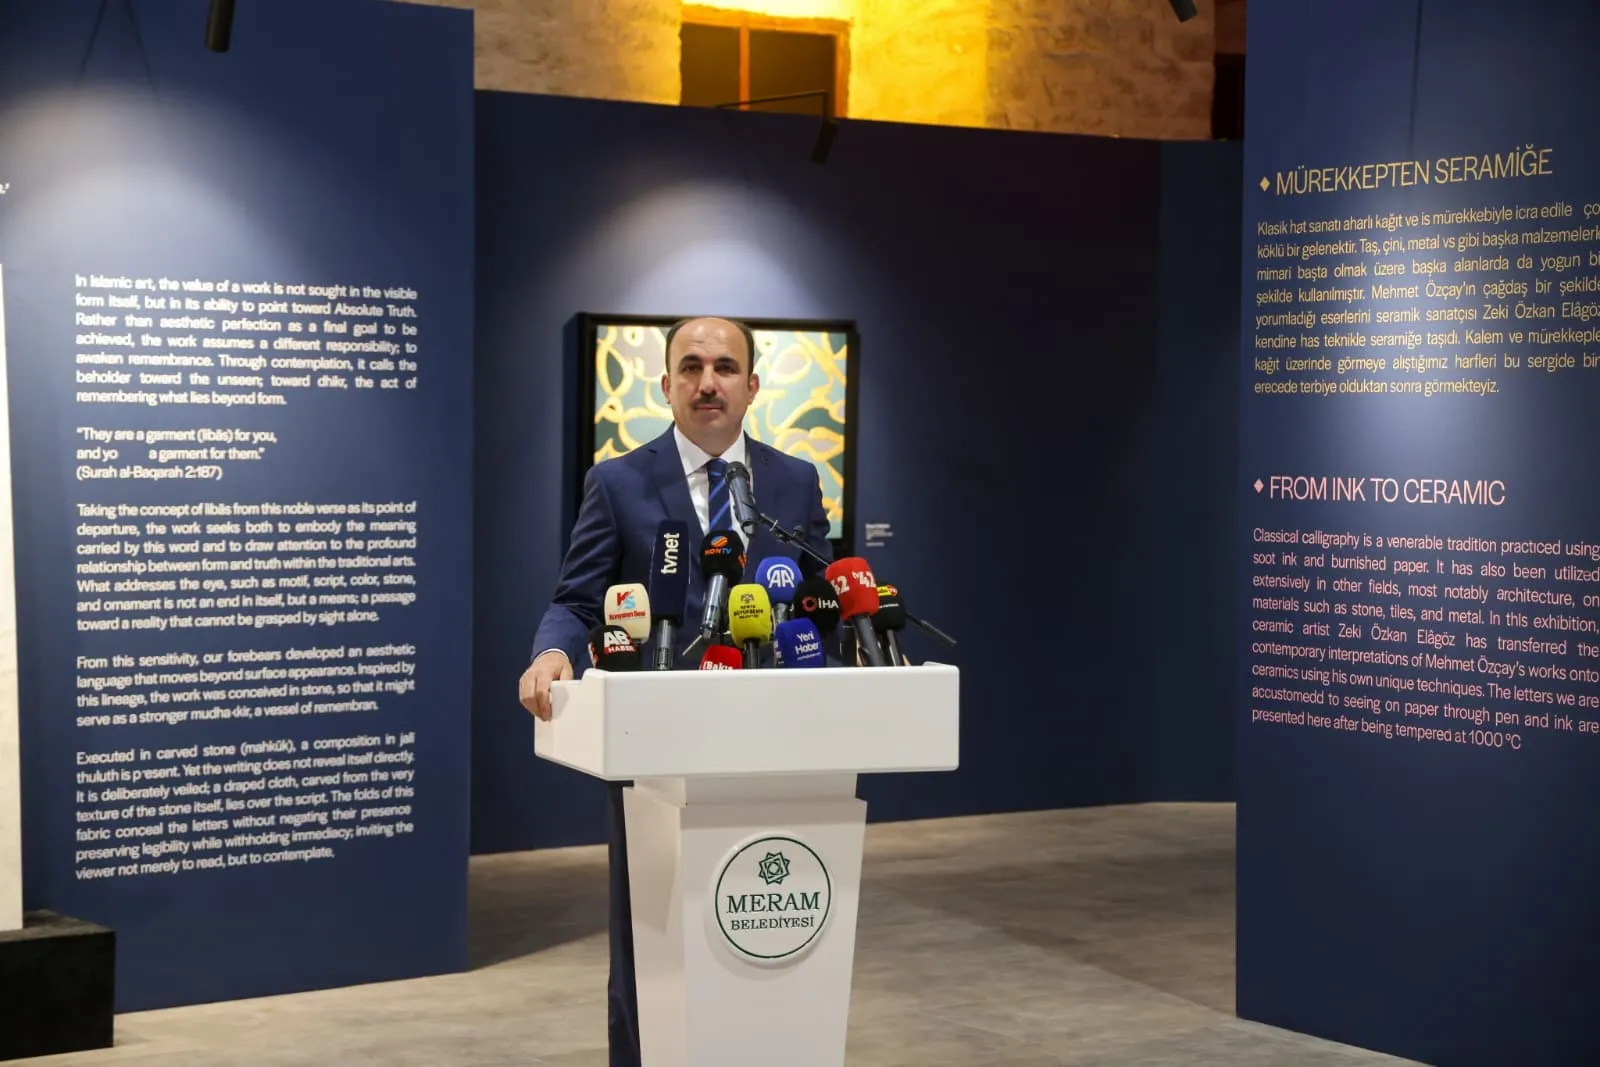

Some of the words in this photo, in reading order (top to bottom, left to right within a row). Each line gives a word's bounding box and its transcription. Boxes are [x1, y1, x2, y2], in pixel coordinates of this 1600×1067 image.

[1277, 161, 1430, 194] MÜREKKEPTEN
[1258, 221, 1288, 235] Klasik
[1290, 220, 1307, 234] hat
[1405, 215, 1419, 226] ve
[1422, 212, 1431, 226] is
[1432, 207, 1513, 224] mürekkebiyle
[1515, 206, 1538, 220] icra
[1540, 202, 1573, 218] edile
[1256, 289, 1293, 306] şekilde
[1372, 285, 1419, 299] Mehmet
[1483, 280, 1528, 299] çağdaş
[1536, 278, 1552, 294] bir
[141, 333, 162, 347] the
[167, 335, 197, 347] work
[202, 338, 255, 349] assumes
[260, 339, 269, 349] a
[273, 337, 321, 351] different
[405, 342, 418, 353] to
[1255, 334, 1297, 348] kendine
[1301, 334, 1320, 348] has
[1323, 332, 1366, 347] teknikle
[1466, 330, 1504, 344] Kalem
[1508, 332, 1523, 343] ve
[1286, 357, 1332, 370] üzerinde
[1337, 356, 1386, 374] görmeye
[1455, 354, 1497, 368] harfleri
[1504, 353, 1520, 368] bu
[1528, 353, 1575, 372] sergide
[1254, 380, 1298, 393] erecede
[1300, 380, 1337, 396] terbiye
[1339, 379, 1388, 393] olduktan
[1390, 381, 1422, 393] sonra
[1425, 378, 1499, 397] görmekteyiz.
[1270, 476, 1327, 500] FROM
[1333, 477, 1366, 501] INK
[1371, 478, 1399, 502] TO
[1404, 479, 1505, 505] CERAMIC
[145, 522, 167, 535] the
[171, 522, 201, 534] work
[206, 521, 241, 534] seeks
[245, 521, 274, 534] both
[278, 522, 291, 533] to
[295, 520, 342, 534] embody
[346, 520, 366, 532] the
[369, 520, 417, 534] meaning
[661, 532, 680, 575] tvnet
[1253, 528, 1299, 543] Classical
[1301, 531, 1360, 549] calligraphy
[1364, 533, 1372, 547] is
[1376, 536, 1383, 548] a
[1387, 536, 1443, 550] venerable
[1447, 537, 1497, 552] tradition
[1501, 541, 1561, 555] practiced
[1566, 542, 1600, 561] using
[767, 568, 795, 588] AA
[1253, 552, 1276, 565] soot
[1282, 552, 1297, 566] ink
[1304, 553, 1324, 567] and
[1331, 555, 1387, 571] burnished
[1394, 561, 1429, 575] paper.
[1437, 560, 1444, 574] It
[1452, 560, 1473, 575] has
[1481, 562, 1506, 577] also
[1514, 562, 1546, 579] been
[1554, 565, 1600, 582] utilized
[818, 597, 839, 609] İHA
[1253, 575, 1310, 592] extensively
[1317, 576, 1326, 590] in
[1333, 578, 1362, 592] other
[1369, 579, 1402, 597] fields,
[1408, 584, 1438, 597] most
[1444, 585, 1489, 603] notably
[1497, 588, 1575, 607] architecture,
[1583, 595, 1600, 607] on
[1253, 597, 1299, 611] materials
[1304, 600, 1330, 613] such
[1334, 603, 1347, 615] as
[1352, 604, 1386, 619] stone,
[1390, 604, 1416, 621] tiles,
[1421, 607, 1443, 621] and
[1448, 610, 1484, 624] metal.
[1490, 610, 1501, 625] In
[1506, 612, 1528, 627] this
[1533, 615, 1599, 633] exhibition,
[603, 630, 630, 646] AB
[794, 642, 819, 655] Haber
[796, 631, 815, 643] Yeni
[77, 656, 108, 669] From
[112, 655, 135, 667] this
[203, 653, 224, 664] our
[227, 650, 282, 662] forebears
[285, 646, 345, 660] developed
[348, 648, 363, 658] an
[366, 644, 416, 656] aesthetic
[1252, 643, 1326, 661] contemporary
[1329, 647, 1409, 666] interpretations
[1411, 653, 1423, 667] of
[1425, 654, 1475, 671] Mehmet
[1528, 664, 1567, 680] works
[1569, 669, 1599, 683] onto
[1252, 665, 1299, 679] ceramics
[1301, 668, 1330, 686] using
[1332, 669, 1348, 684] his
[1349, 674, 1373, 686] own
[1375, 675, 1415, 692] unique
[1416, 678, 1485, 698] techniques.
[1490, 683, 1512, 699] The
[1514, 686, 1554, 704] letters
[1556, 693, 1576, 706] we
[1578, 695, 1600, 708] are
[1252, 709, 1305, 725] presented
[1307, 712, 1332, 728] here
[1333, 715, 1359, 731] after
[1361, 718, 1393, 739] being
[1395, 724, 1452, 742] tempered
[1453, 730, 1467, 743] at
[1468, 729, 1503, 746] 1000
[76, 828, 111, 841] fabric
[115, 822, 164, 838] conceal
[168, 821, 188, 834] the
[192, 819, 229, 831] letters
[232, 815, 276, 828] without
[279, 811, 329, 827] negating
[332, 808, 357, 820] their
[361, 805, 412, 820] presence
[726, 891, 821, 914] MERAM
[731, 915, 815, 931] BELEDİYESİ
